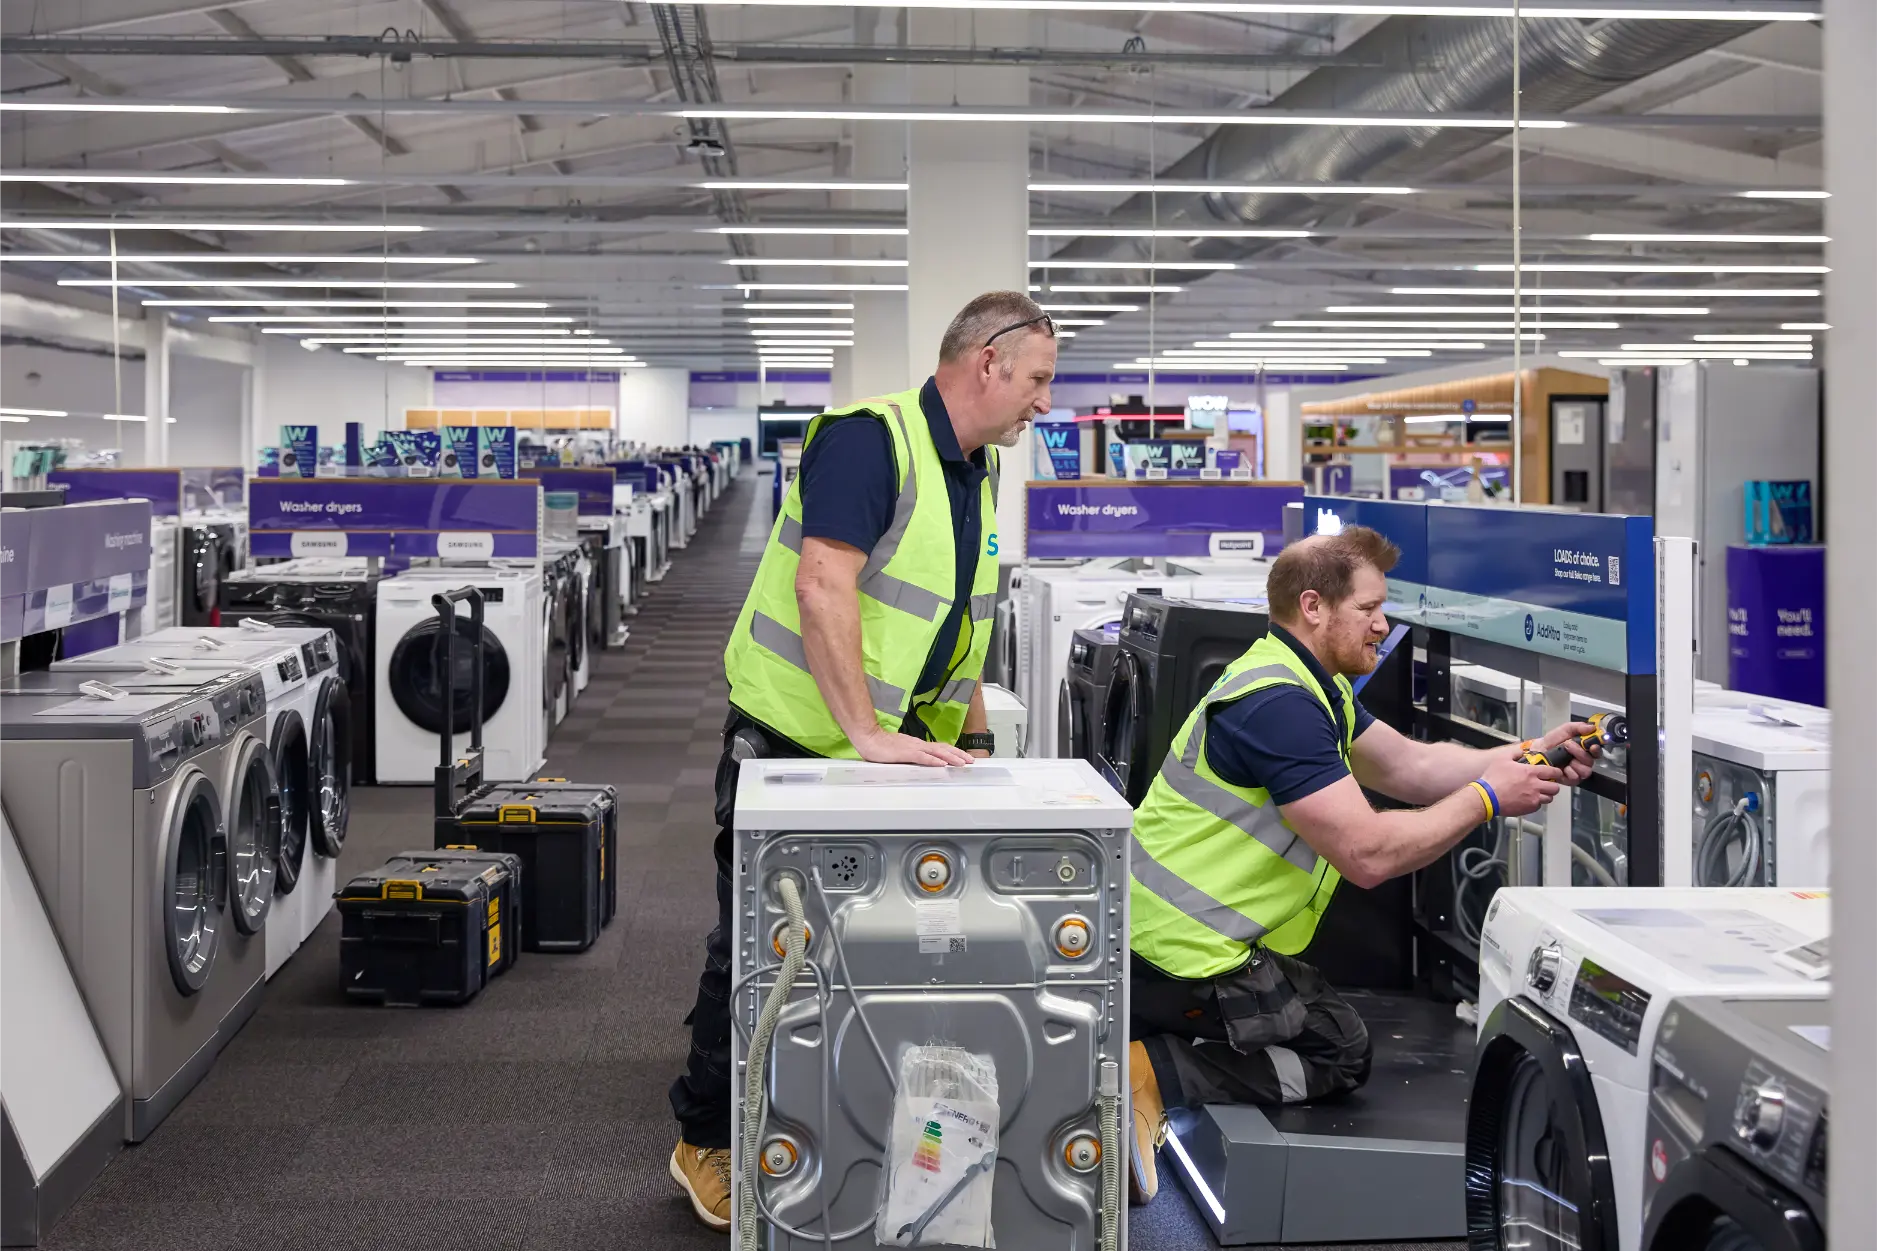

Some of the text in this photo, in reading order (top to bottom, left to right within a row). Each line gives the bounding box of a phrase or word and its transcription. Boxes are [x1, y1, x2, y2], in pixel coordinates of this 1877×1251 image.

[1043, 431, 1068, 448] W
[280, 500, 363, 515] Washer dryers
[1057, 503, 1138, 518] Washer dryers
[1554, 549, 1600, 567] LOADS of choice.
[1777, 607, 1812, 623] You'll
[1777, 622, 1814, 637] need.
